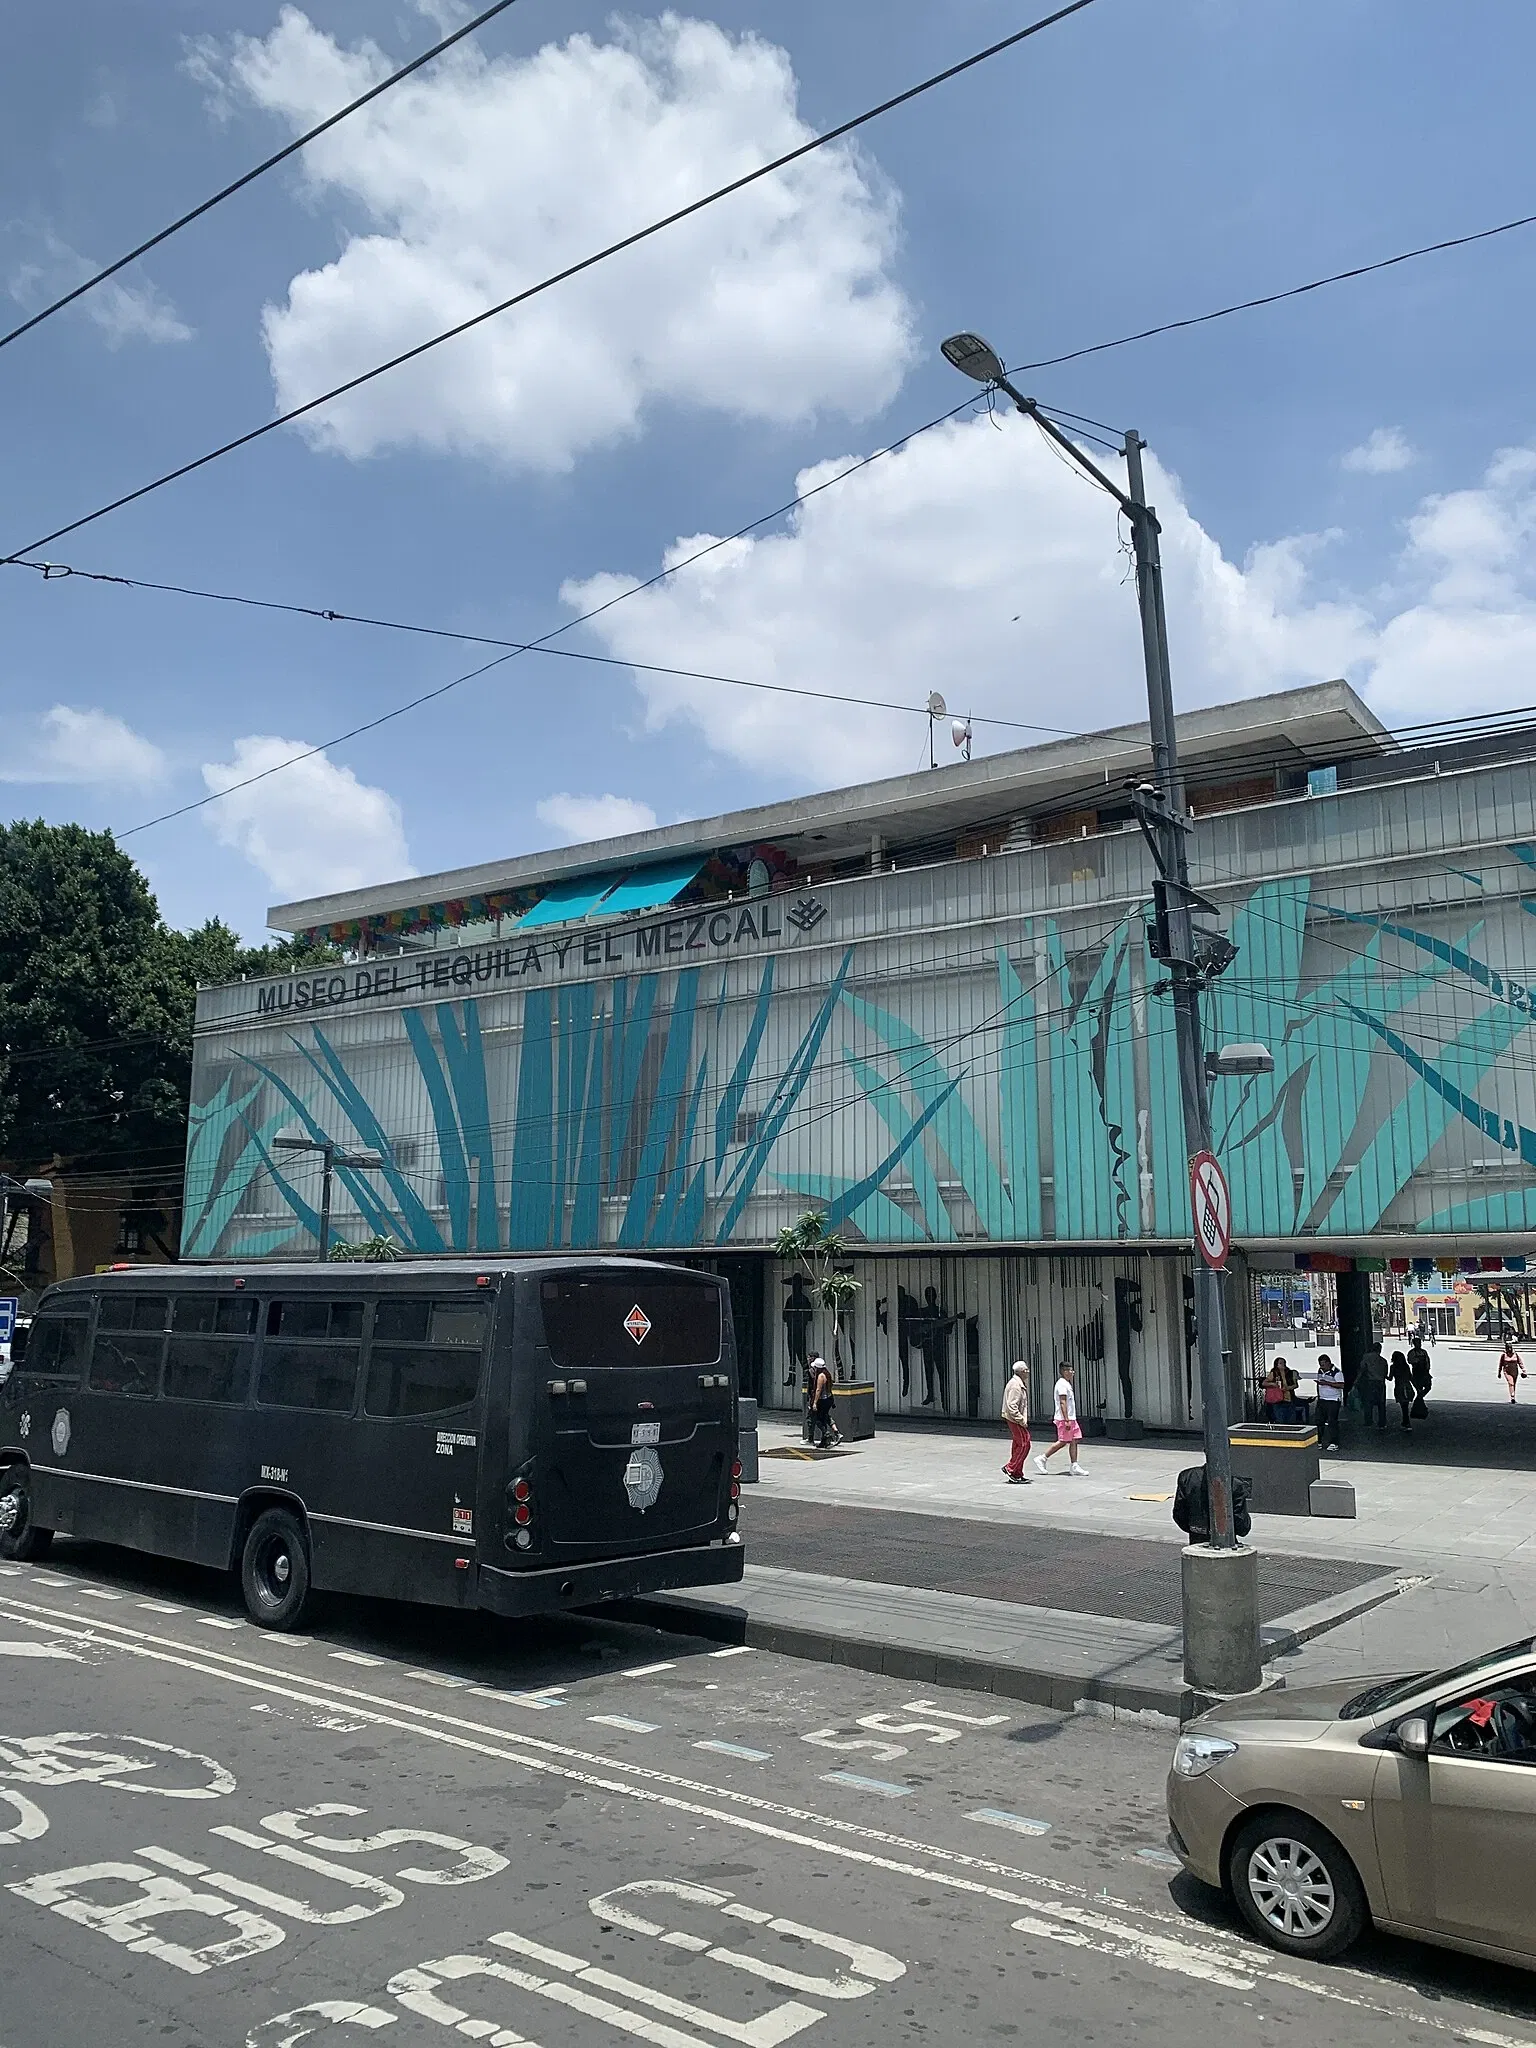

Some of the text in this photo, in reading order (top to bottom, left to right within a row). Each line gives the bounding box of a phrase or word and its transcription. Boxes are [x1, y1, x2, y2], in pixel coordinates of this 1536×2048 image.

[257, 905, 782, 1014] MUSEO DEL TEQUILA Y EL MEZCAL
[435, 1443, 454, 1456] ZONA
[454, 1509, 471, 1521] 911
[3, 1802, 511, 1975] BUS
